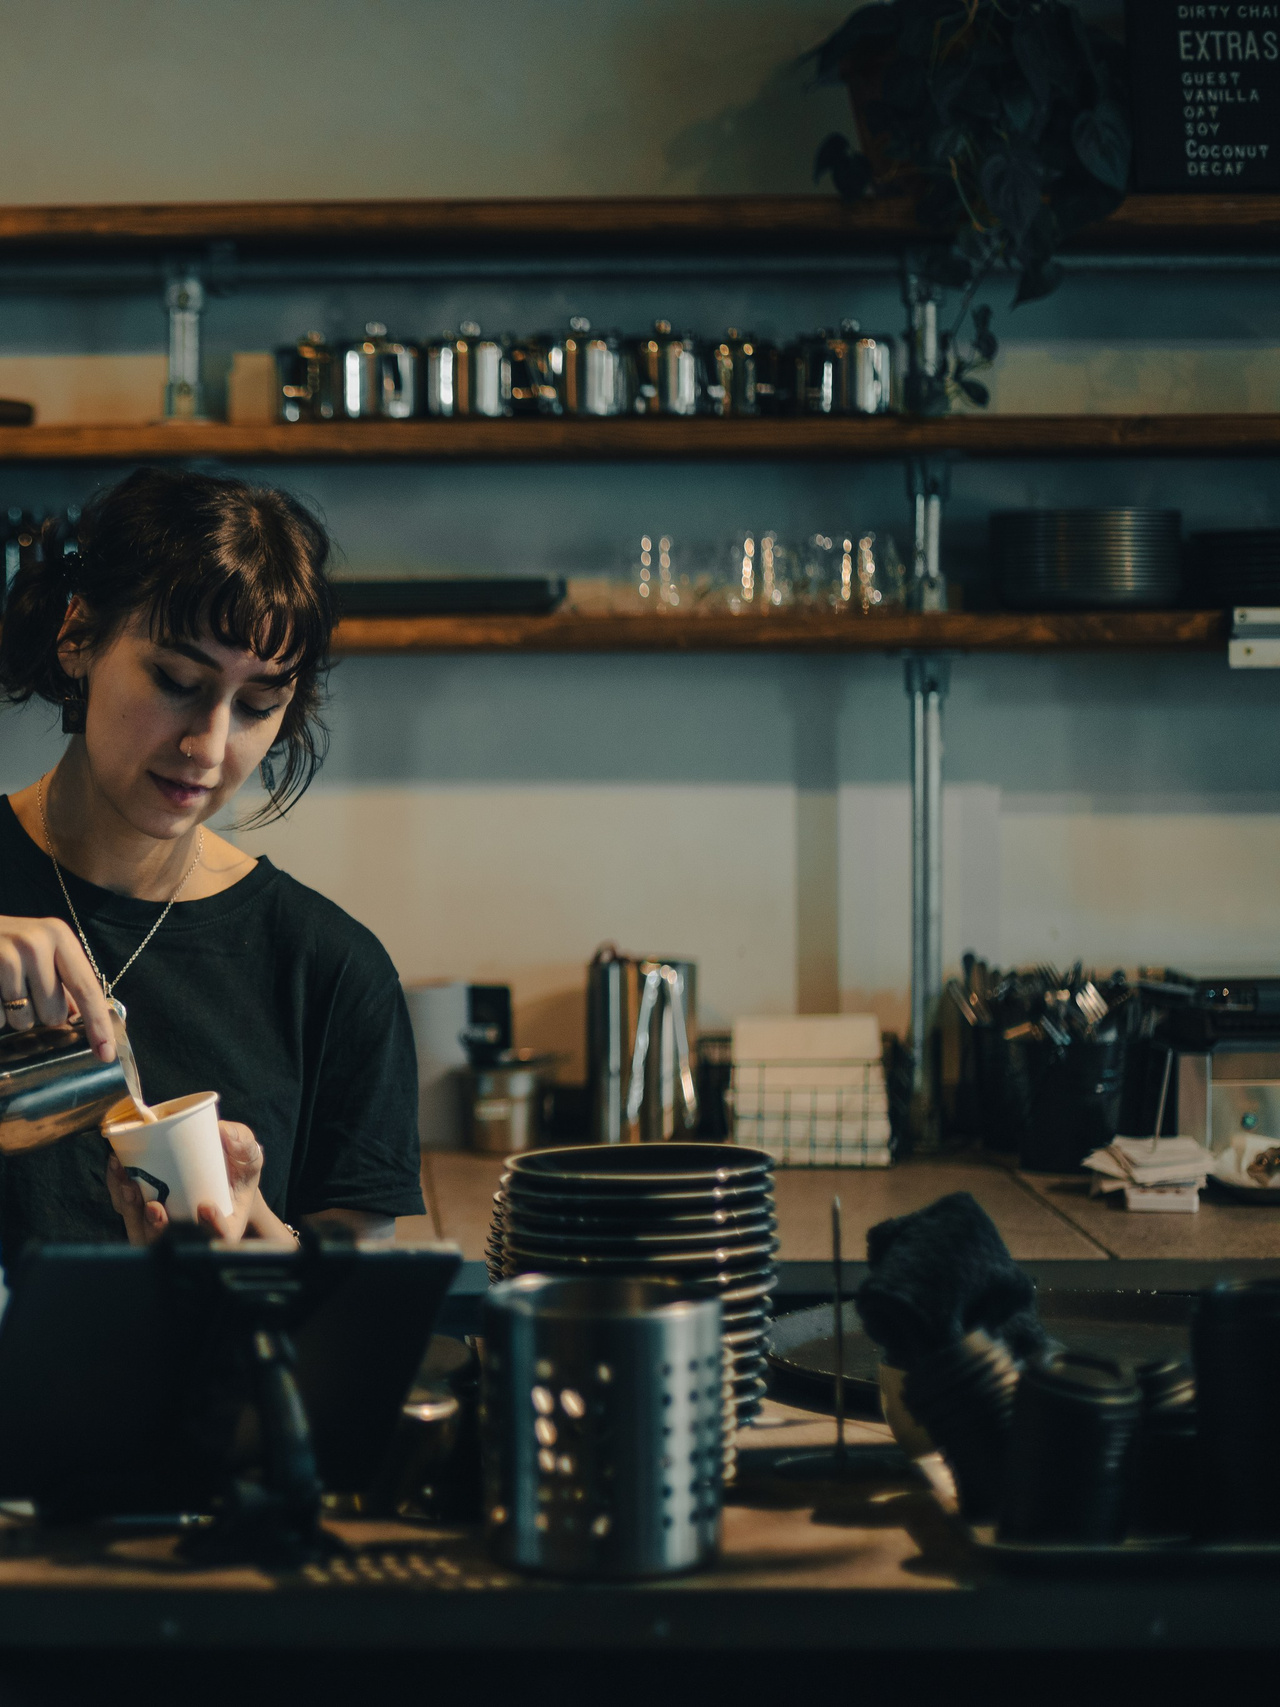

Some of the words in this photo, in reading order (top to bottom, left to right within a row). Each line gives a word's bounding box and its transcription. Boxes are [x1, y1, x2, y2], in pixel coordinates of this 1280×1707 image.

[1177, 5, 1231, 19] DIRTY
[1236, 5, 1279, 19] CHAI
[1178, 30, 1279, 61] EXTRAS
[1181, 71, 1241, 86] GUEST
[1183, 88, 1260, 103] VANILLA
[1183, 105, 1219, 120] OAT
[1184, 122, 1221, 137] SOY
[1186, 161, 1246, 176] DECAF
